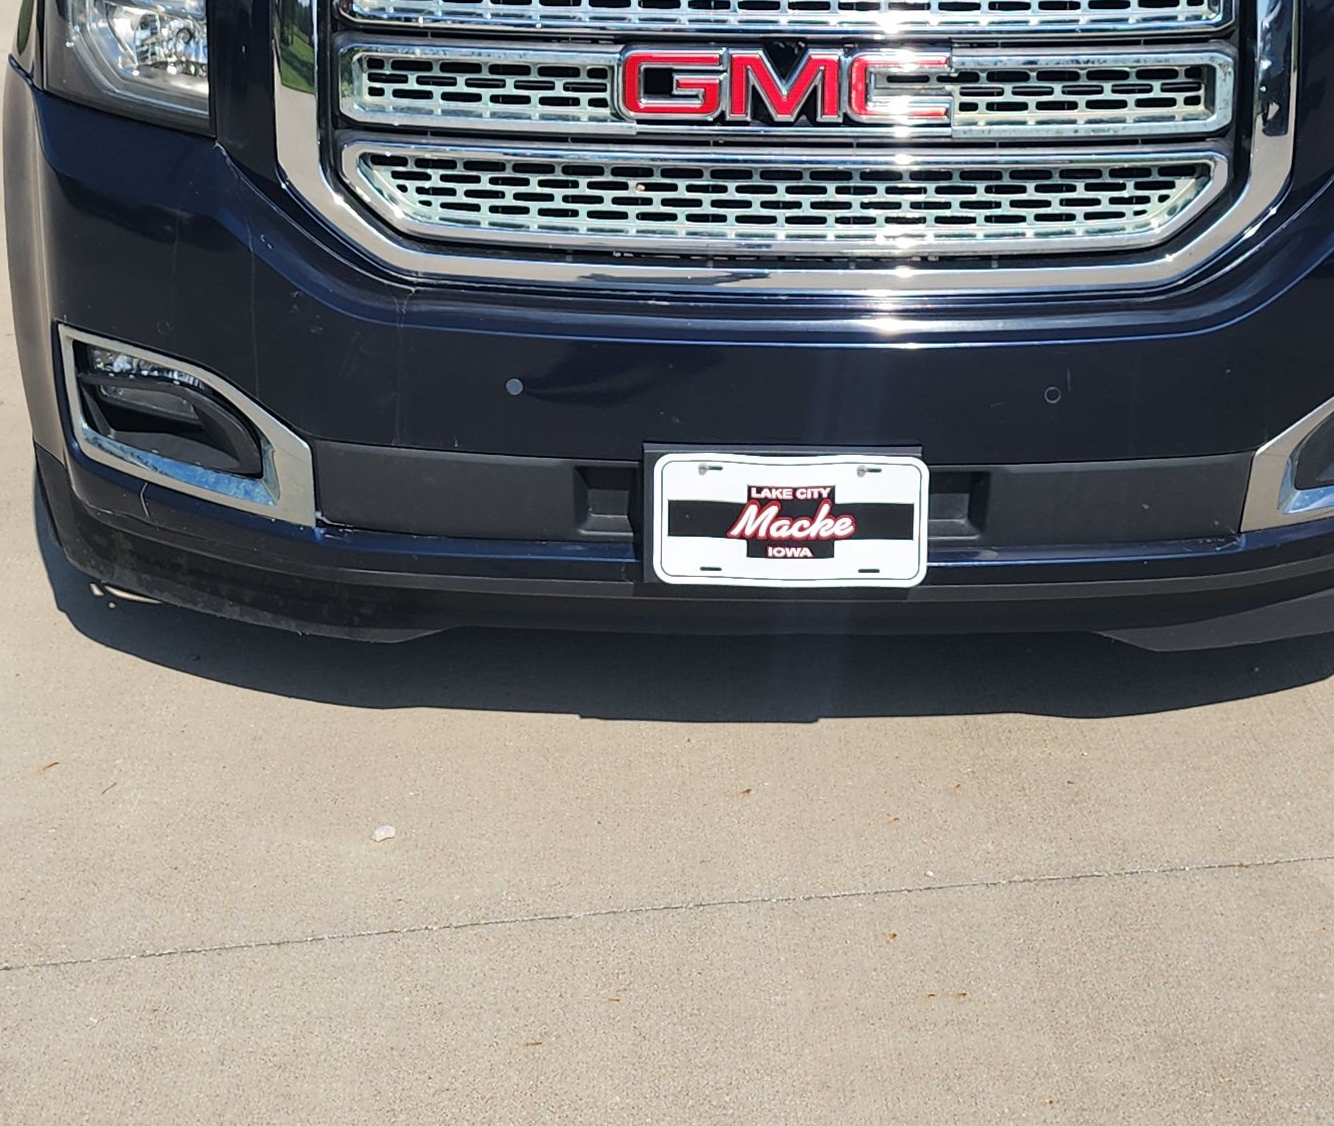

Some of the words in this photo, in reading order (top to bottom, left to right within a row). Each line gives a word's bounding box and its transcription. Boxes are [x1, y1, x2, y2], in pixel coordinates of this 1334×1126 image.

[618, 46, 953, 123] GMC
[751, 487, 793, 499] LAKE
[796, 488, 831, 500] CITY
[727, 500, 856, 540] Macke
[768, 547, 812, 558] IOWA
